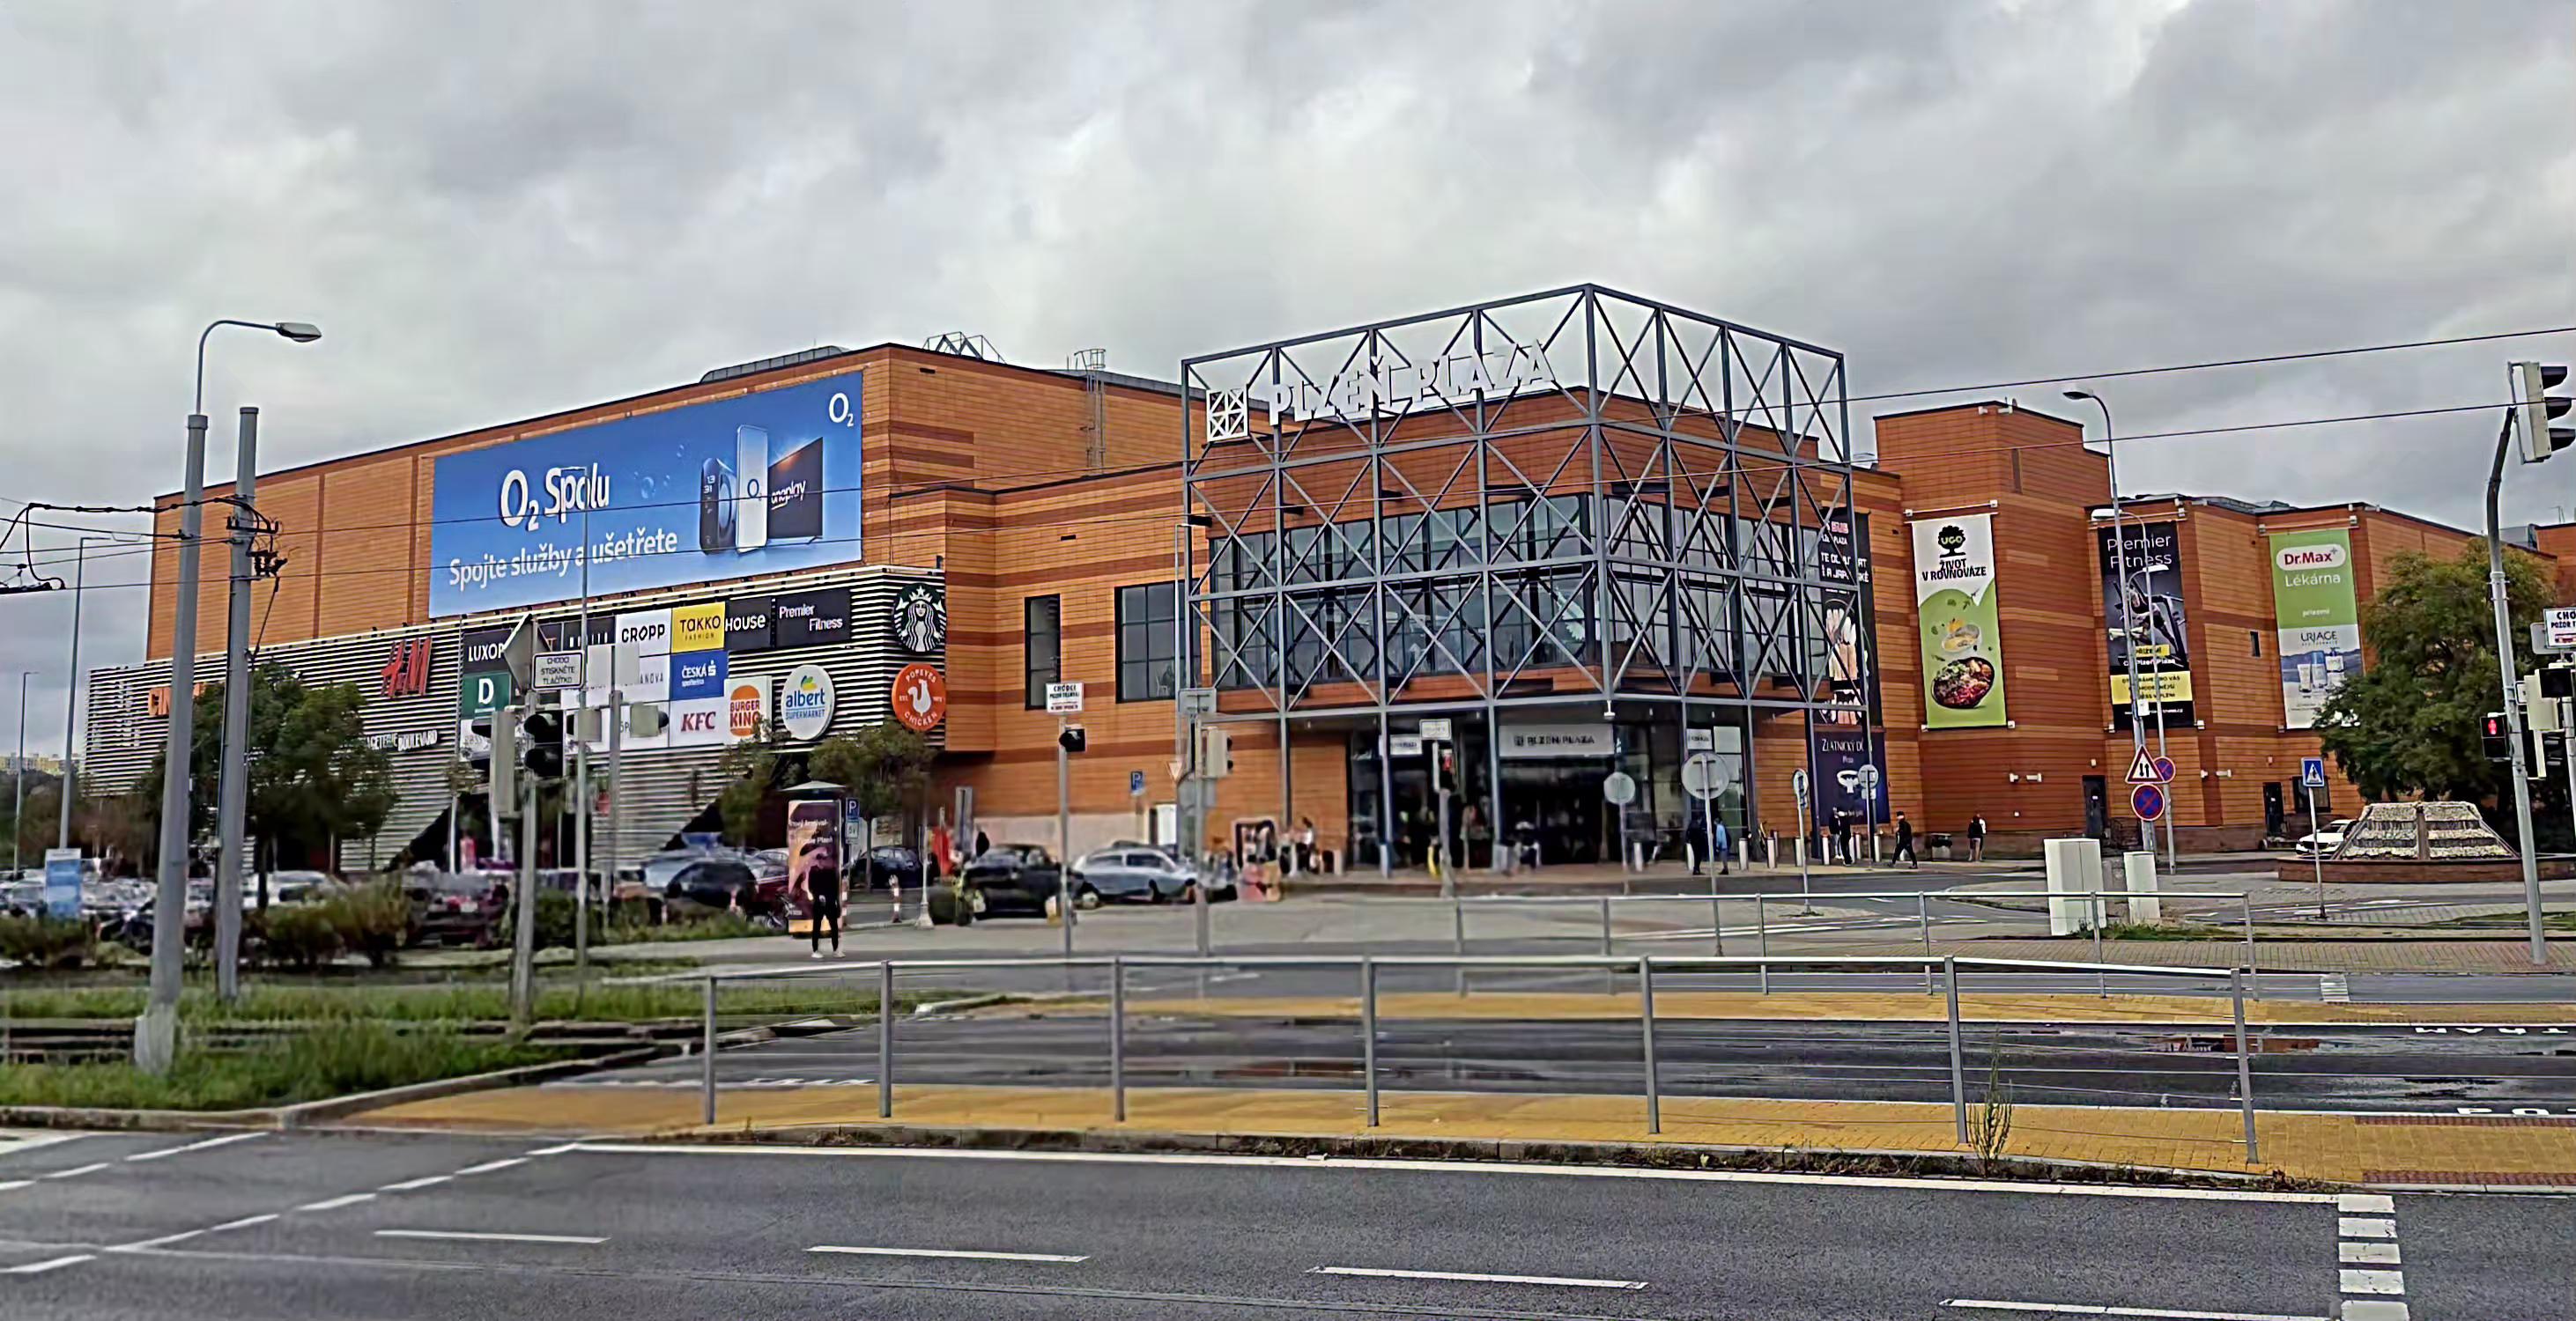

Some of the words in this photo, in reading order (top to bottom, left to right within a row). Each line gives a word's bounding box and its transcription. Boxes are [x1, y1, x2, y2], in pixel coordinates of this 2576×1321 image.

[2107, 533, 2171, 551] Pemier
[449, 557, 507, 592] Spojte
[510, 542, 572, 577] služby
[574, 546, 584, 566] a
[592, 527, 677, 565] ušetřete
[1939, 558, 1966, 572] ŽIVOT
[2111, 554, 2173, 569] Ftness
[1922, 572, 1928, 581] V
[2284, 572, 2341, 587] Lékárna
[779, 603, 815, 619] Premier
[621, 624, 665, 644] CROPP
[729, 699, 760, 712] BURGER
[785, 687, 825, 708] albert
[680, 711, 716, 733] KFC
[785, 708, 825, 720] SUPERMARKET
[904, 711, 937, 727] CHICKEN
